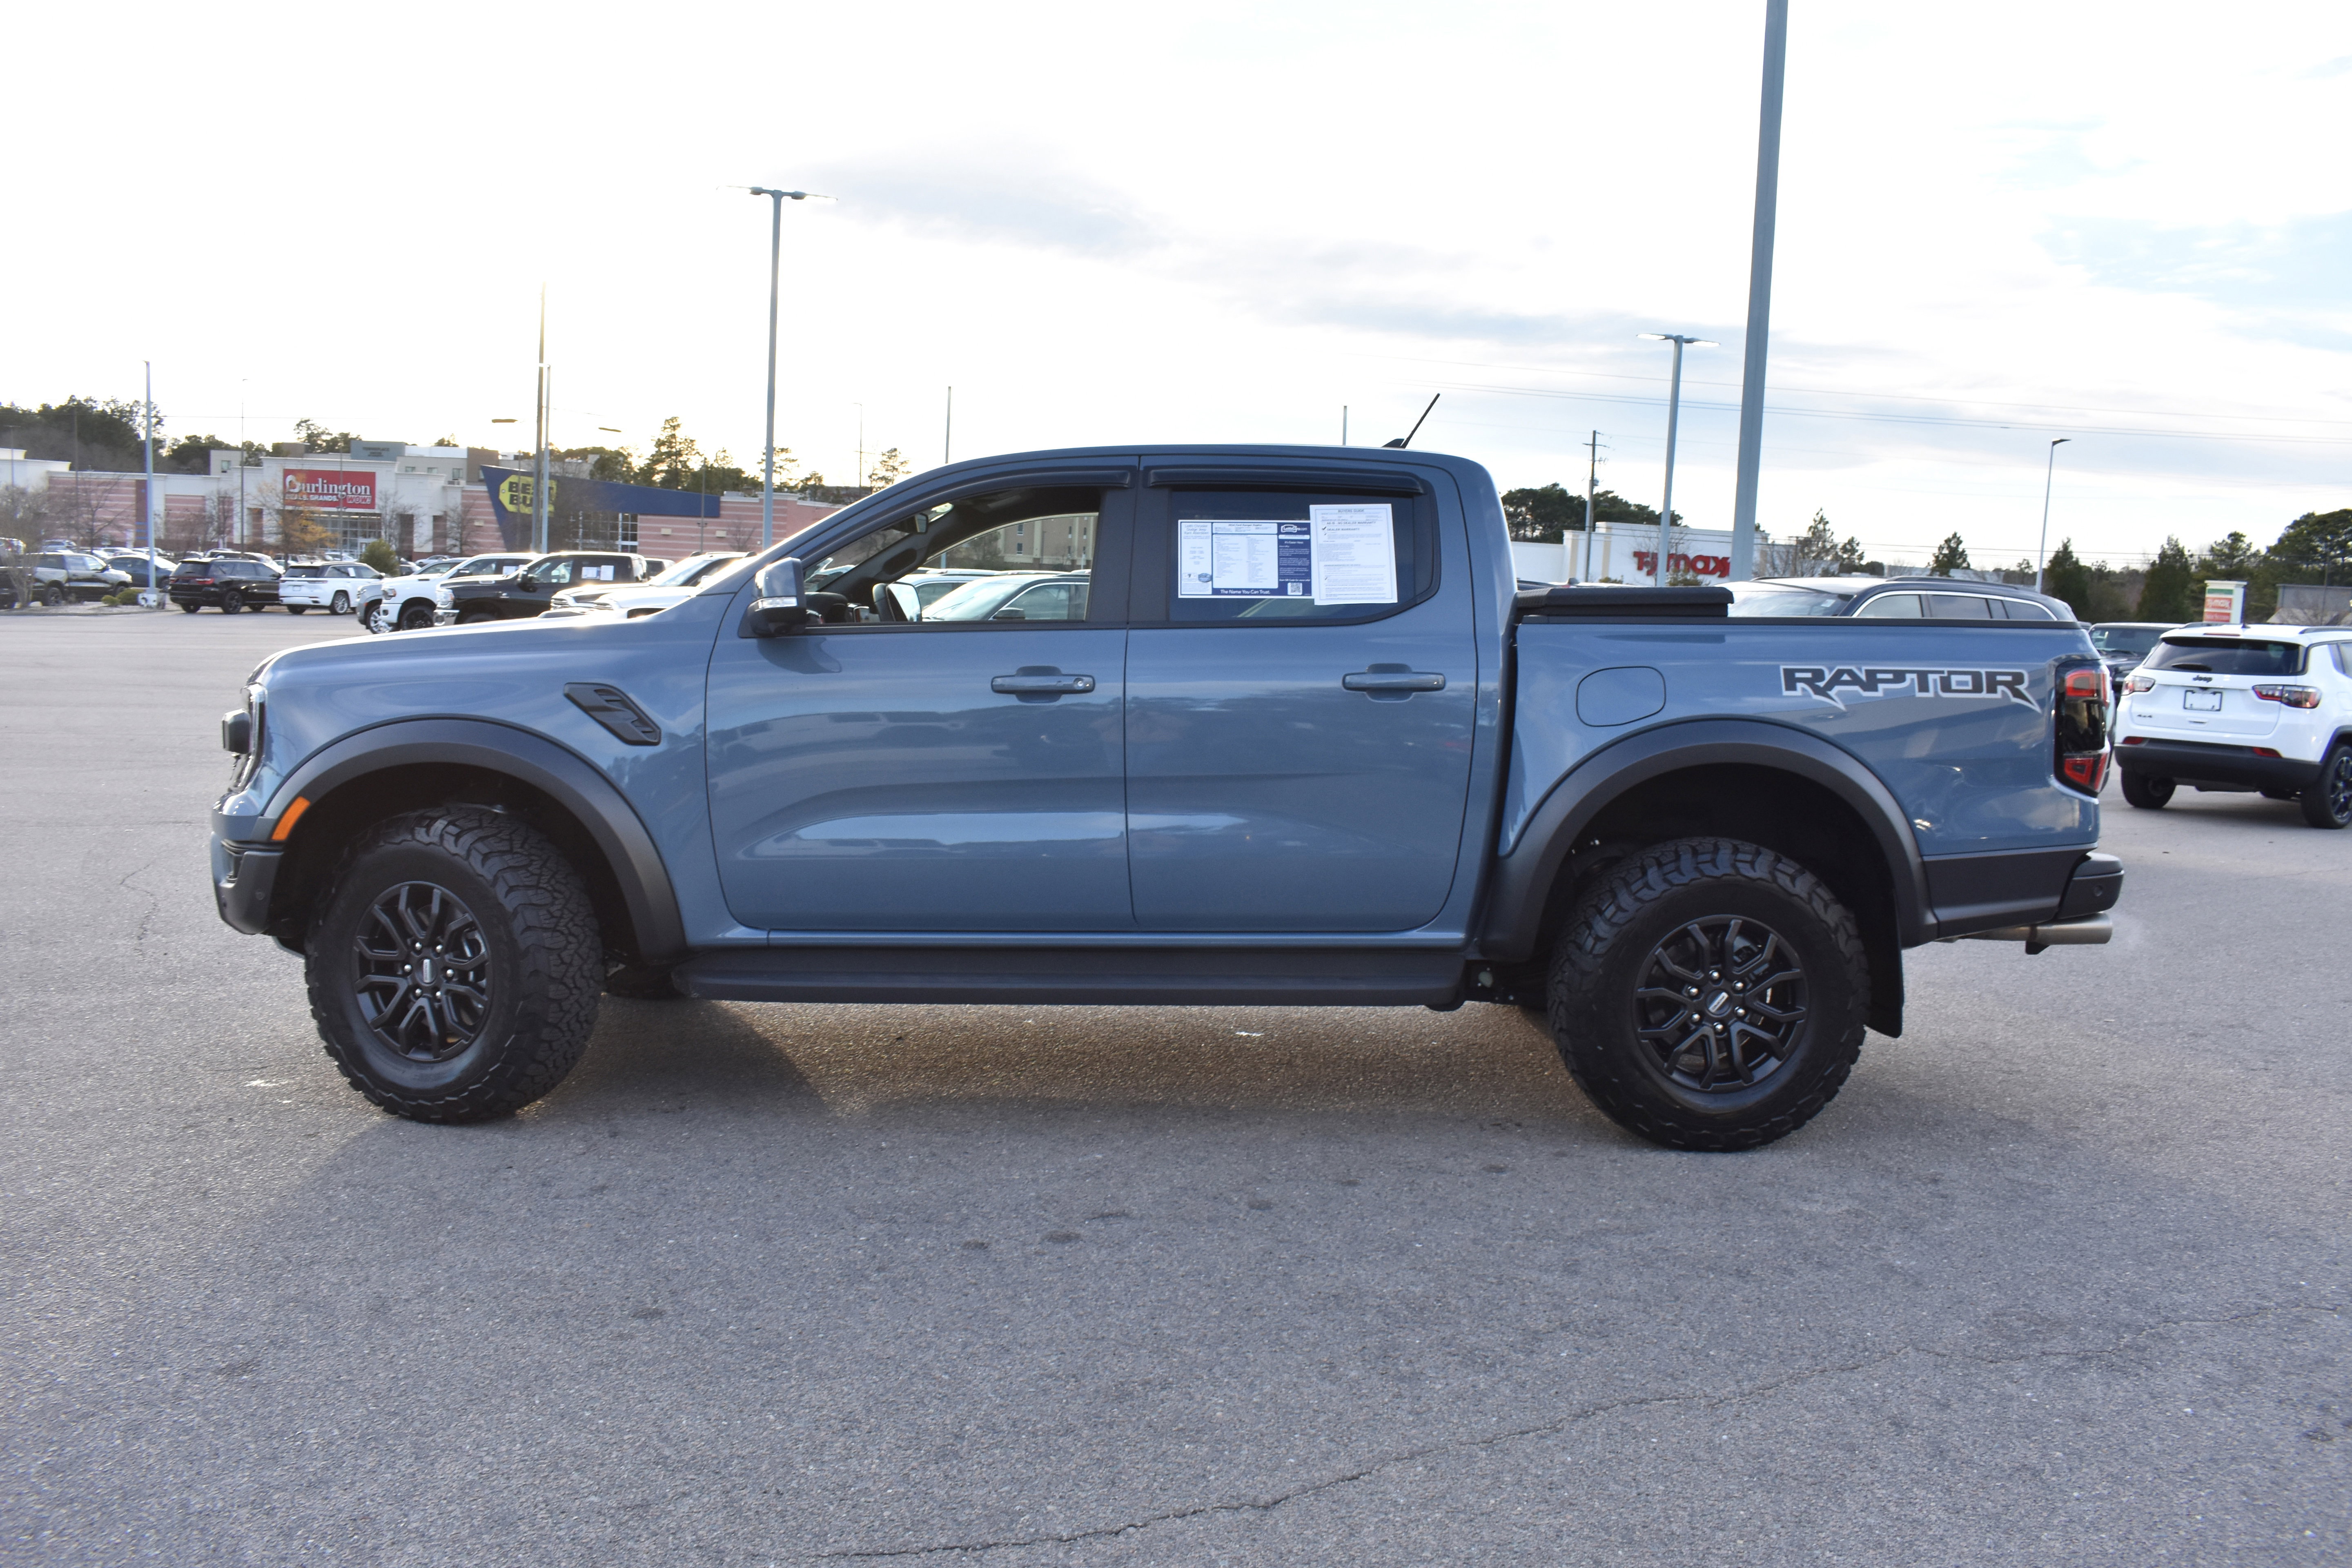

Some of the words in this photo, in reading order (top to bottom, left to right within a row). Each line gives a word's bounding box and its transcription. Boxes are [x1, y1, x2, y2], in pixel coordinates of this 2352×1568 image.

[286, 474, 371, 499] Burlington
[347, 495, 372, 504] WOW!
[2192, 675, 2213, 683] Jeep
[1780, 665, 2042, 713] RAPTOR
